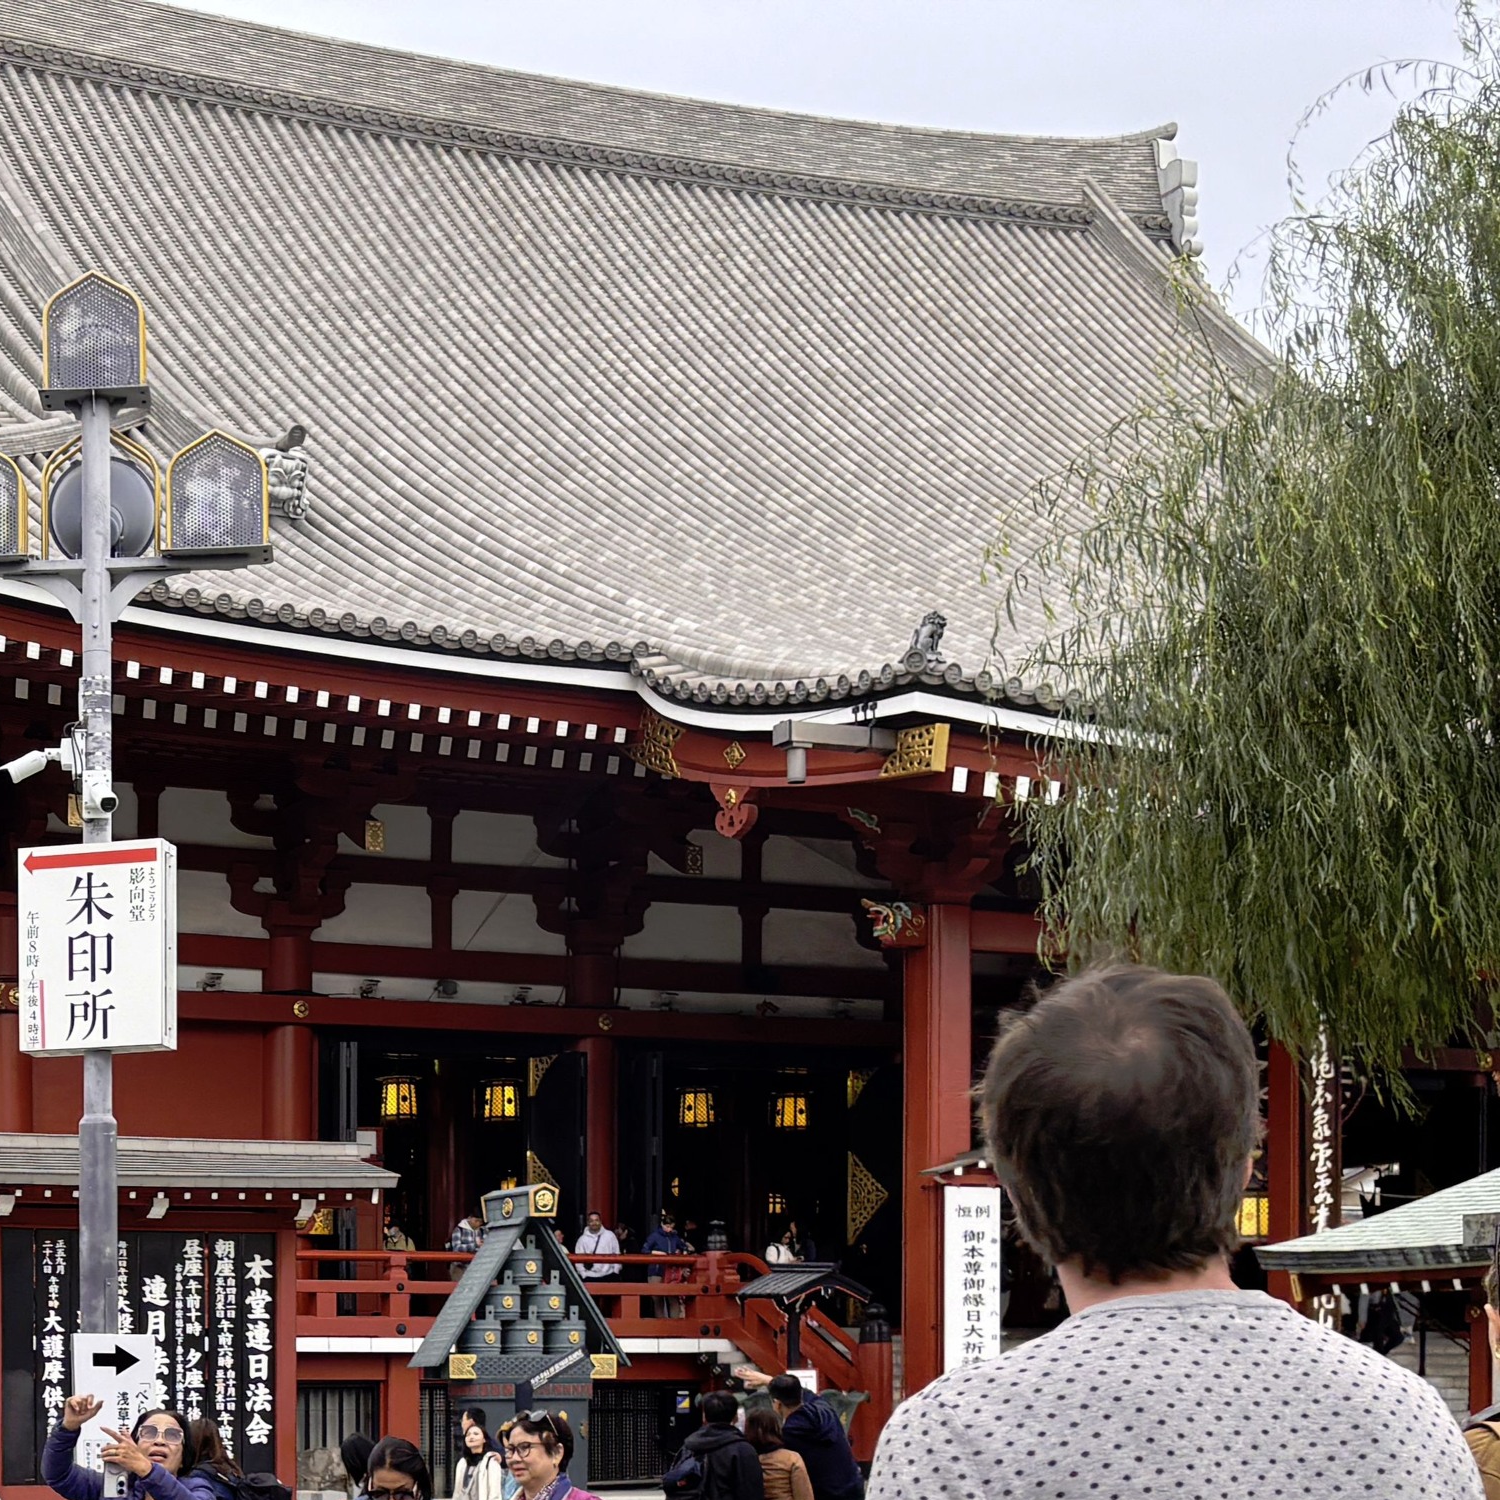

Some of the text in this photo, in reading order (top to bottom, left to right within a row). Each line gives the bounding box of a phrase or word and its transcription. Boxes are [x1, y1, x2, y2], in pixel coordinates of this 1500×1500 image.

[129, 866, 146, 923] 影向堂
[148, 866, 157, 922] ようごうどう
[65, 871, 116, 1042] 朱印所
[955, 1205, 991, 1219] 恒例
[42, 1239, 54, 1275] 二十八日
[55, 1239, 67, 1275] 正五九月
[182, 1238, 204, 1277] 昼座
[213, 1238, 236, 1277] 朝座
[48, 1275, 60, 1309] 午前十時
[185, 1278, 203, 1337] 午前十時
[41, 1309, 66, 1409] 大護摩供
[217, 1319, 235, 1369] 午前六時
[244, 1253, 274, 1446] 本堂連日法会
[184, 1347, 205, 1388] 夕座
